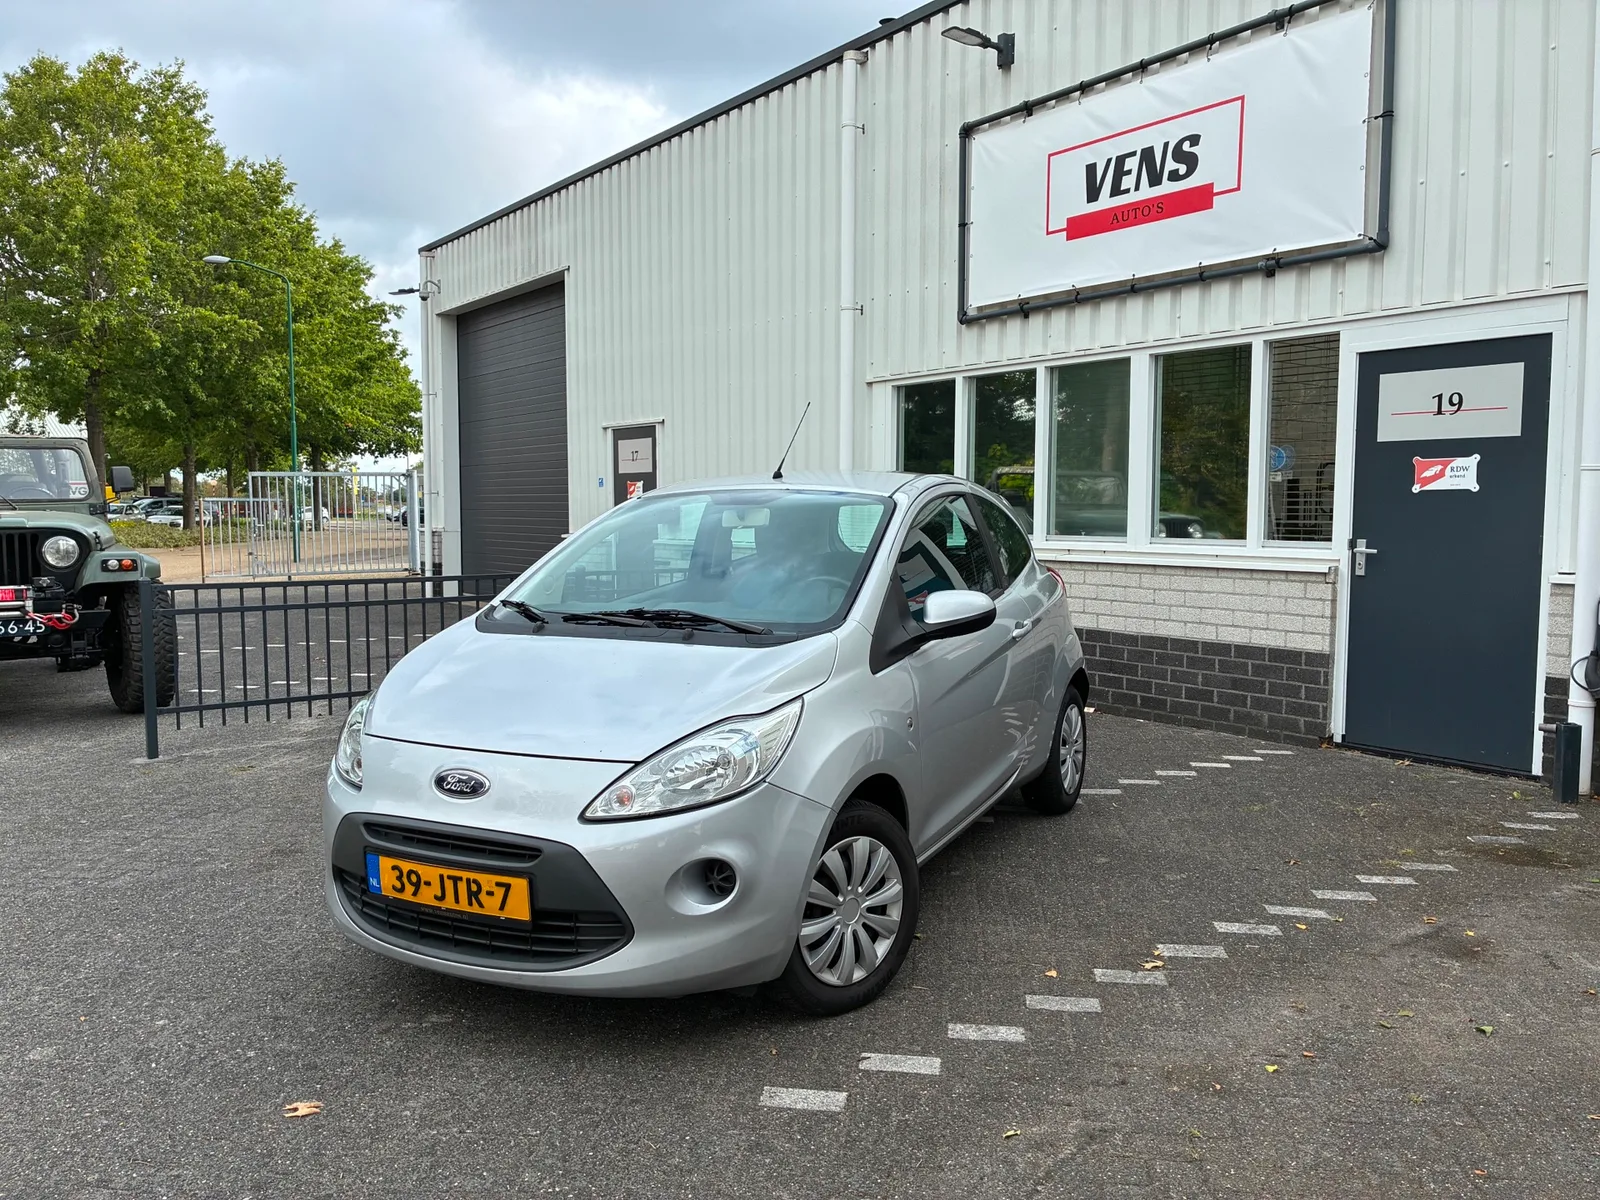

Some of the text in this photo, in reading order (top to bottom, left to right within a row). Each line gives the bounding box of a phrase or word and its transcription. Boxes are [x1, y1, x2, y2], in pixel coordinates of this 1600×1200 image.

[1085, 133, 1202, 205] VENS
[1109, 202, 1165, 226] AUTO'S
[1432, 391, 1464, 416] 19
[631, 450, 639, 462] 17
[1450, 465, 1470, 473] RDW
[69, 486, 88, 496] VG
[443, 773, 476, 792] Ford
[369, 876, 380, 888] NL
[390, 864, 512, 912] 39-JTR-7
